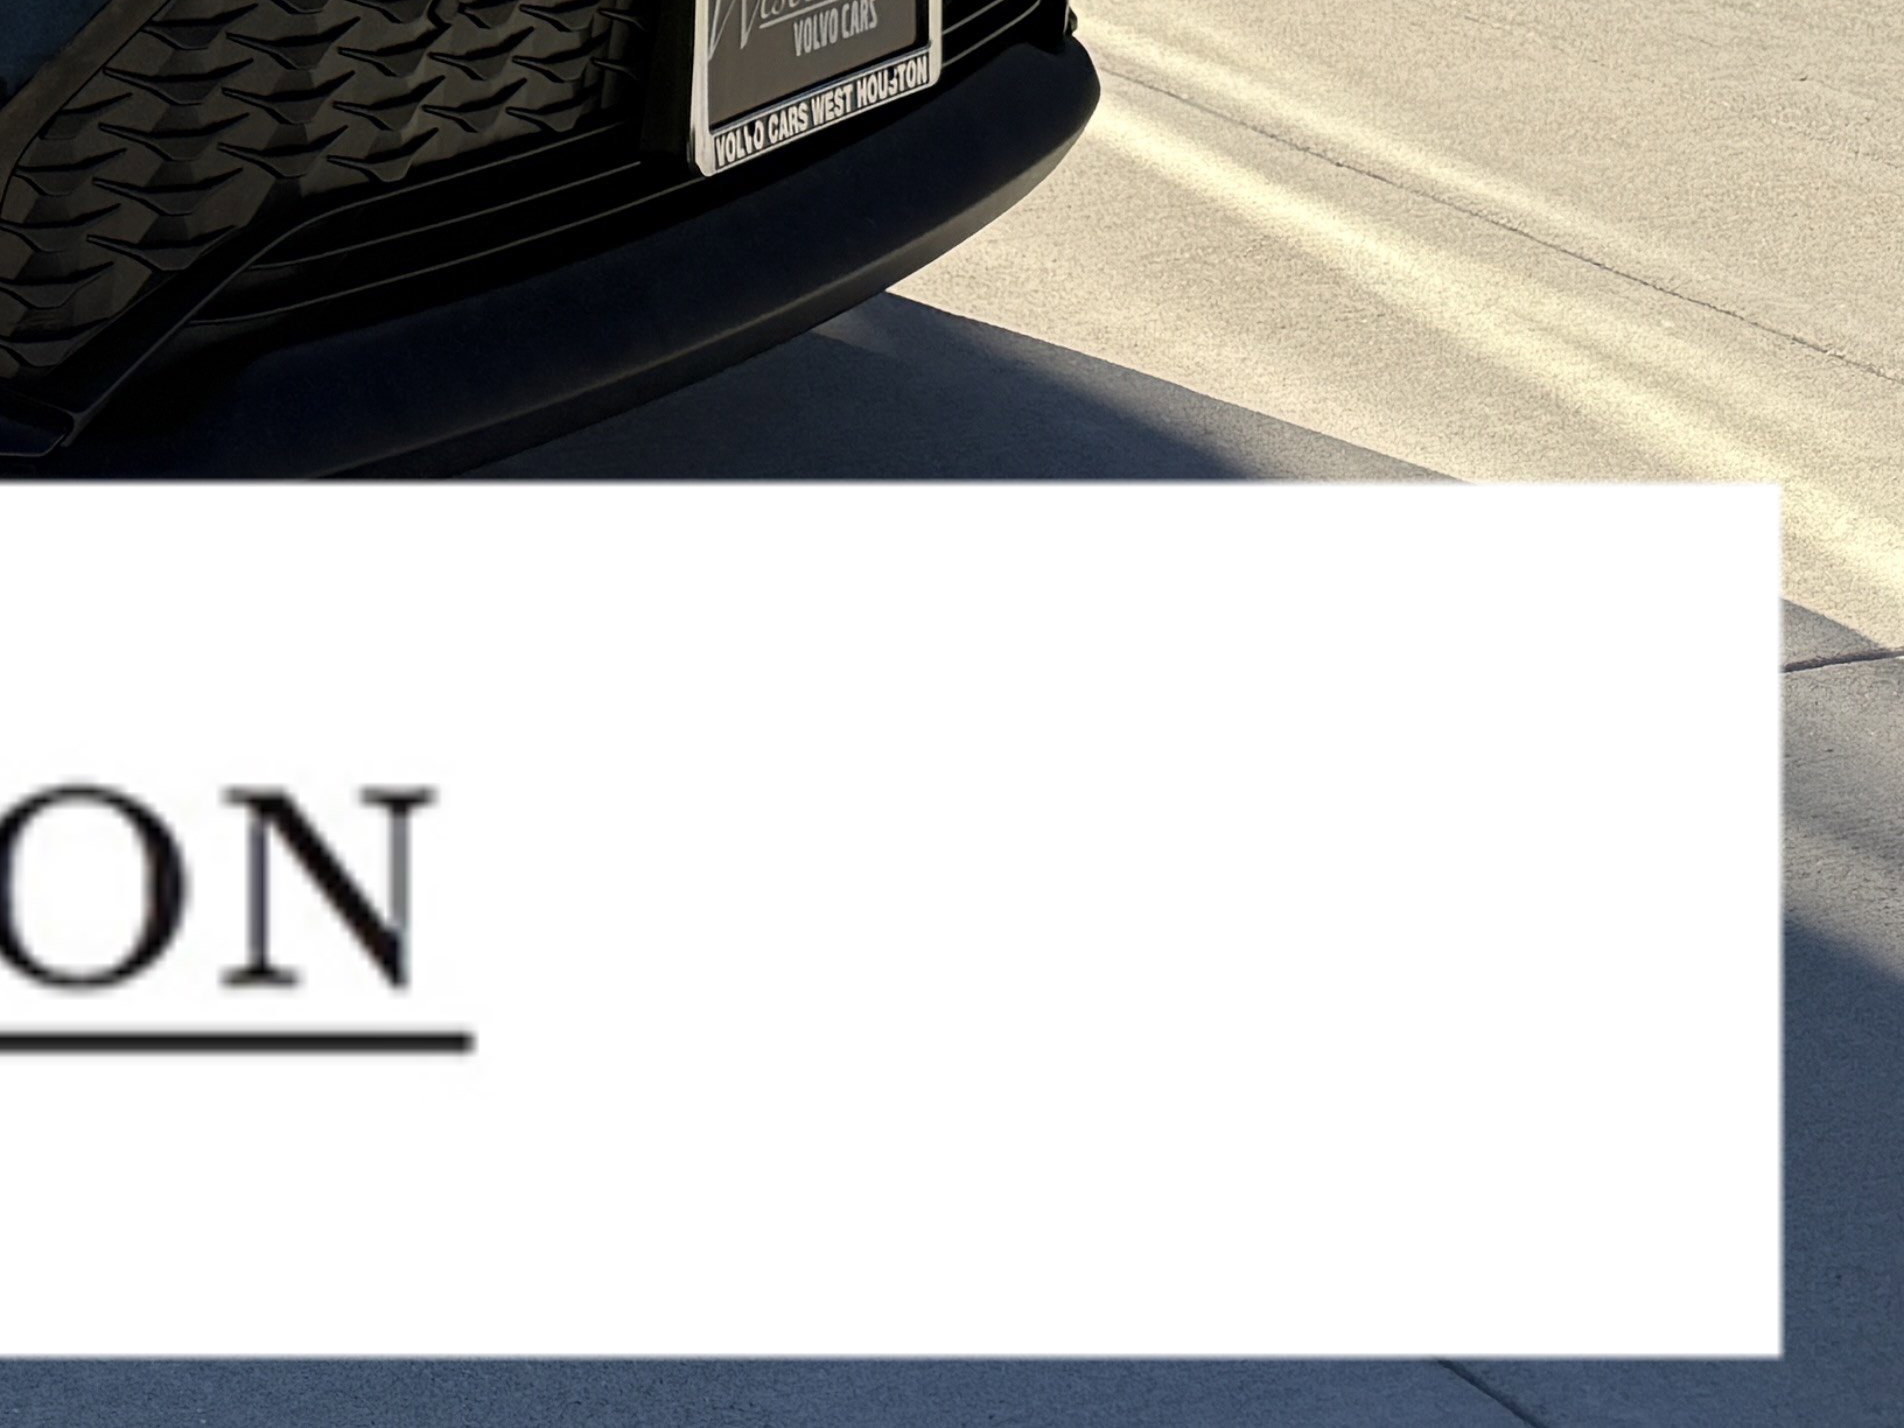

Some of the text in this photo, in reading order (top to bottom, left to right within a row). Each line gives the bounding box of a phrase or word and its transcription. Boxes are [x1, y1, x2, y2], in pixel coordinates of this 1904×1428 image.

[793, 8, 839, 56] VOLVO
[715, 55, 927, 167] VOLVO CARS WEST HOUSTON
